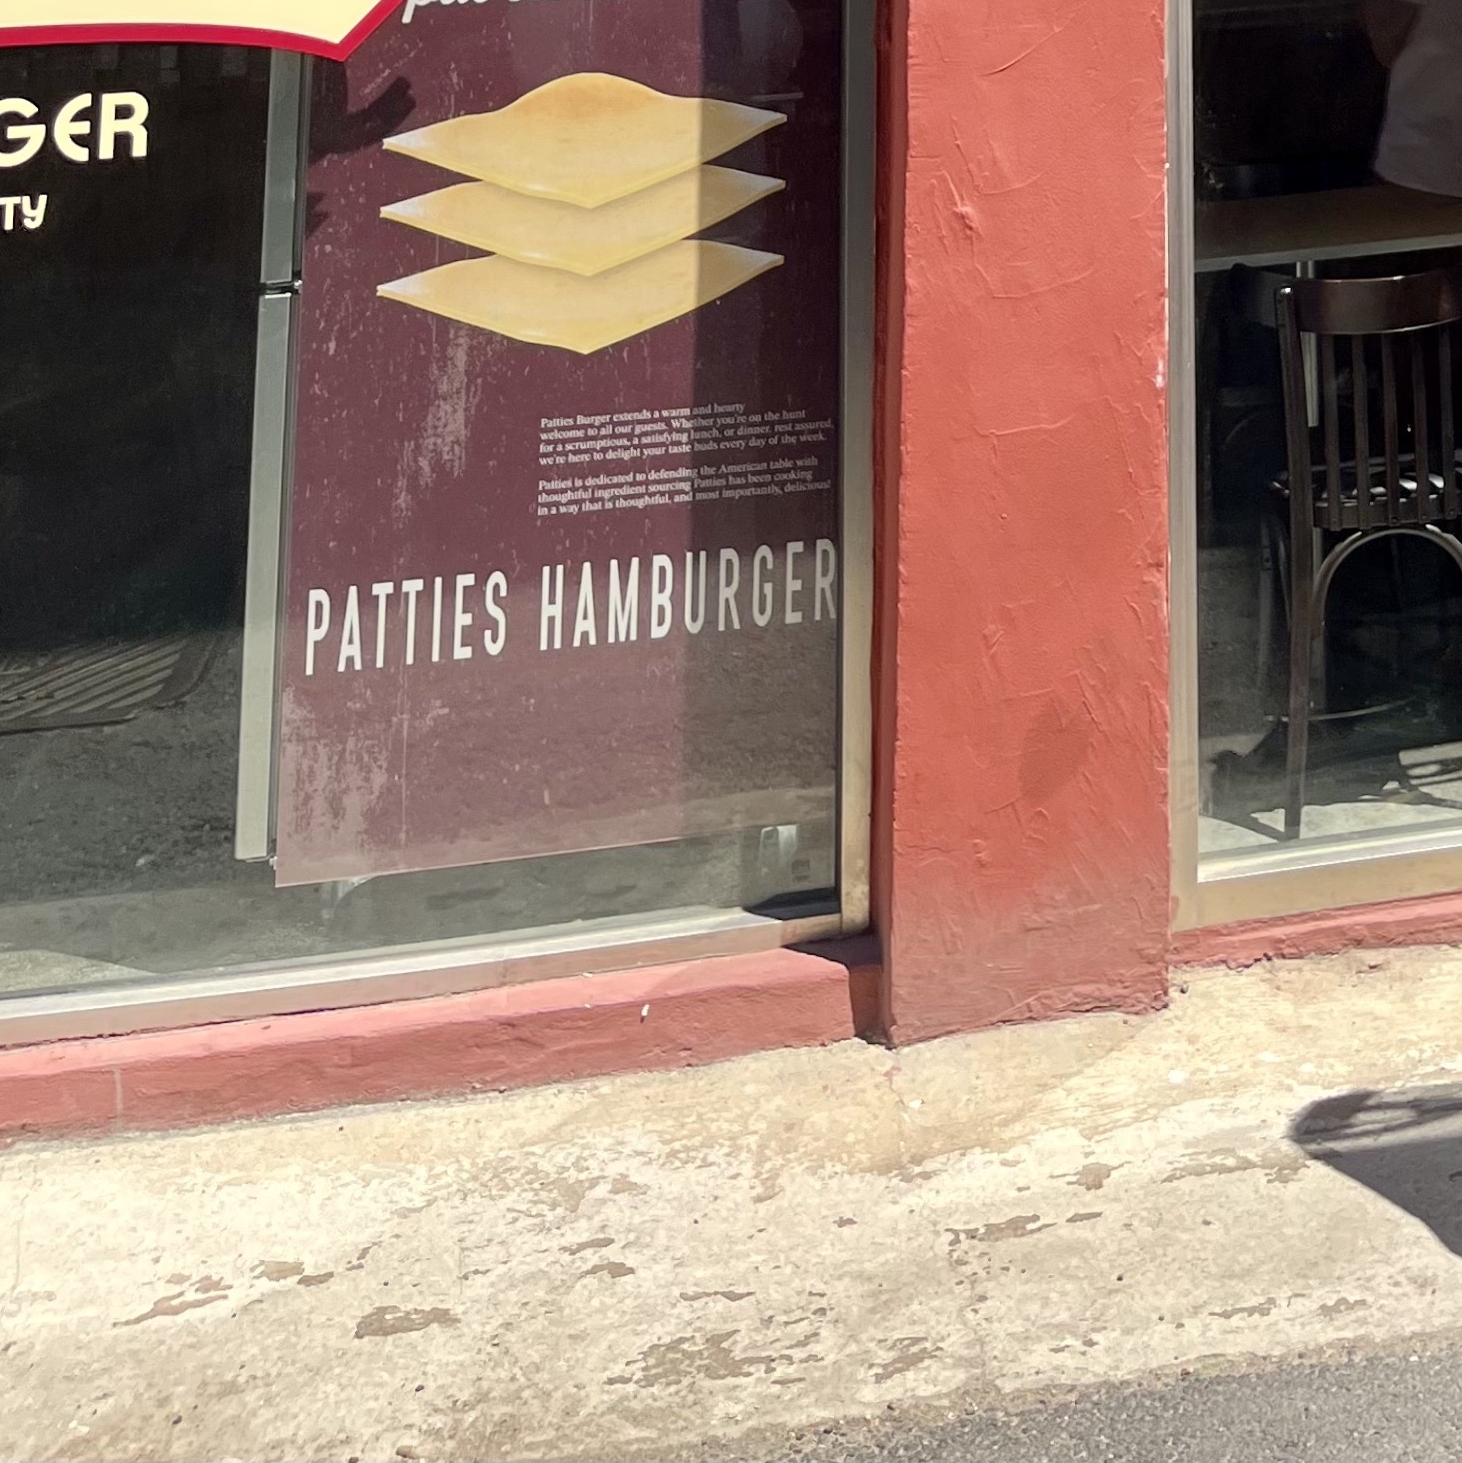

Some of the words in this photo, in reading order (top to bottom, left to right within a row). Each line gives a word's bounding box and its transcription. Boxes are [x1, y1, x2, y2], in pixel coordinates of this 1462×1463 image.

[540, 428, 585, 440] welcome
[588, 427, 597, 435] to
[600, 425, 612, 434] all
[615, 424, 632, 434] our
[671, 416, 713, 430] Whether
[716, 415, 746, 429] you're
[749, 414, 761, 422] on
[764, 411, 780, 421] the
[783, 409, 806, 419] hunt
[541, 417, 574, 428] Patties
[576, 414, 611, 426] Burger
[613, 409, 651, 421] extends
[653, 410, 659, 418] a
[661, 408, 690, 417] warm
[692, 404, 711, 415] and
[714, 403, 745, 414] hearty
[539, 454, 566, 465] we're
[568, 453, 591, 463] here
[594, 451, 603, 460] to
[606, 448, 640, 460] delight
[643, 447, 666, 459] your
[669, 444, 691, 454] taste
[694, 441, 718, 451] buds
[720, 440, 746, 450] every
[749, 437, 766, 448] day
[769, 436, 779, 445] of
[782, 434, 796, 444] the
[540, 442, 554, 453] for
[633, 437, 639, 445] a
[641, 431, 688, 445] satisfying
[724, 428, 735, 436] or
[775, 423, 792, 432] rest
[538, 489, 591, 503] thoughtful
[595, 484, 646, 499] ingredient
[648, 480, 691, 493] sourcing
[694, 476, 726, 488] Patties
[729, 475, 745, 485] has
[748, 473, 771, 483] been
[774, 469, 813, 482] cooking
[539, 479, 572, 490] Patties
[575, 477, 582, 487] is
[585, 472, 633, 486] dedicated
[636, 471, 646, 480] to
[648, 467, 698, 480] defending
[701, 465, 717, 475] the
[719, 461, 767, 473] American
[770, 458, 793, 469] table
[538, 506, 548, 515] in
[551, 506, 557, 514] a
[559, 504, 579, 515] way
[582, 501, 602, 511] that
[605, 499, 613, 509] is
[674, 492, 693, 503] and
[695, 490, 719, 500] most
[304, 570, 508, 676] PATTIES
[538, 538, 837, 652] HAMBURGER
